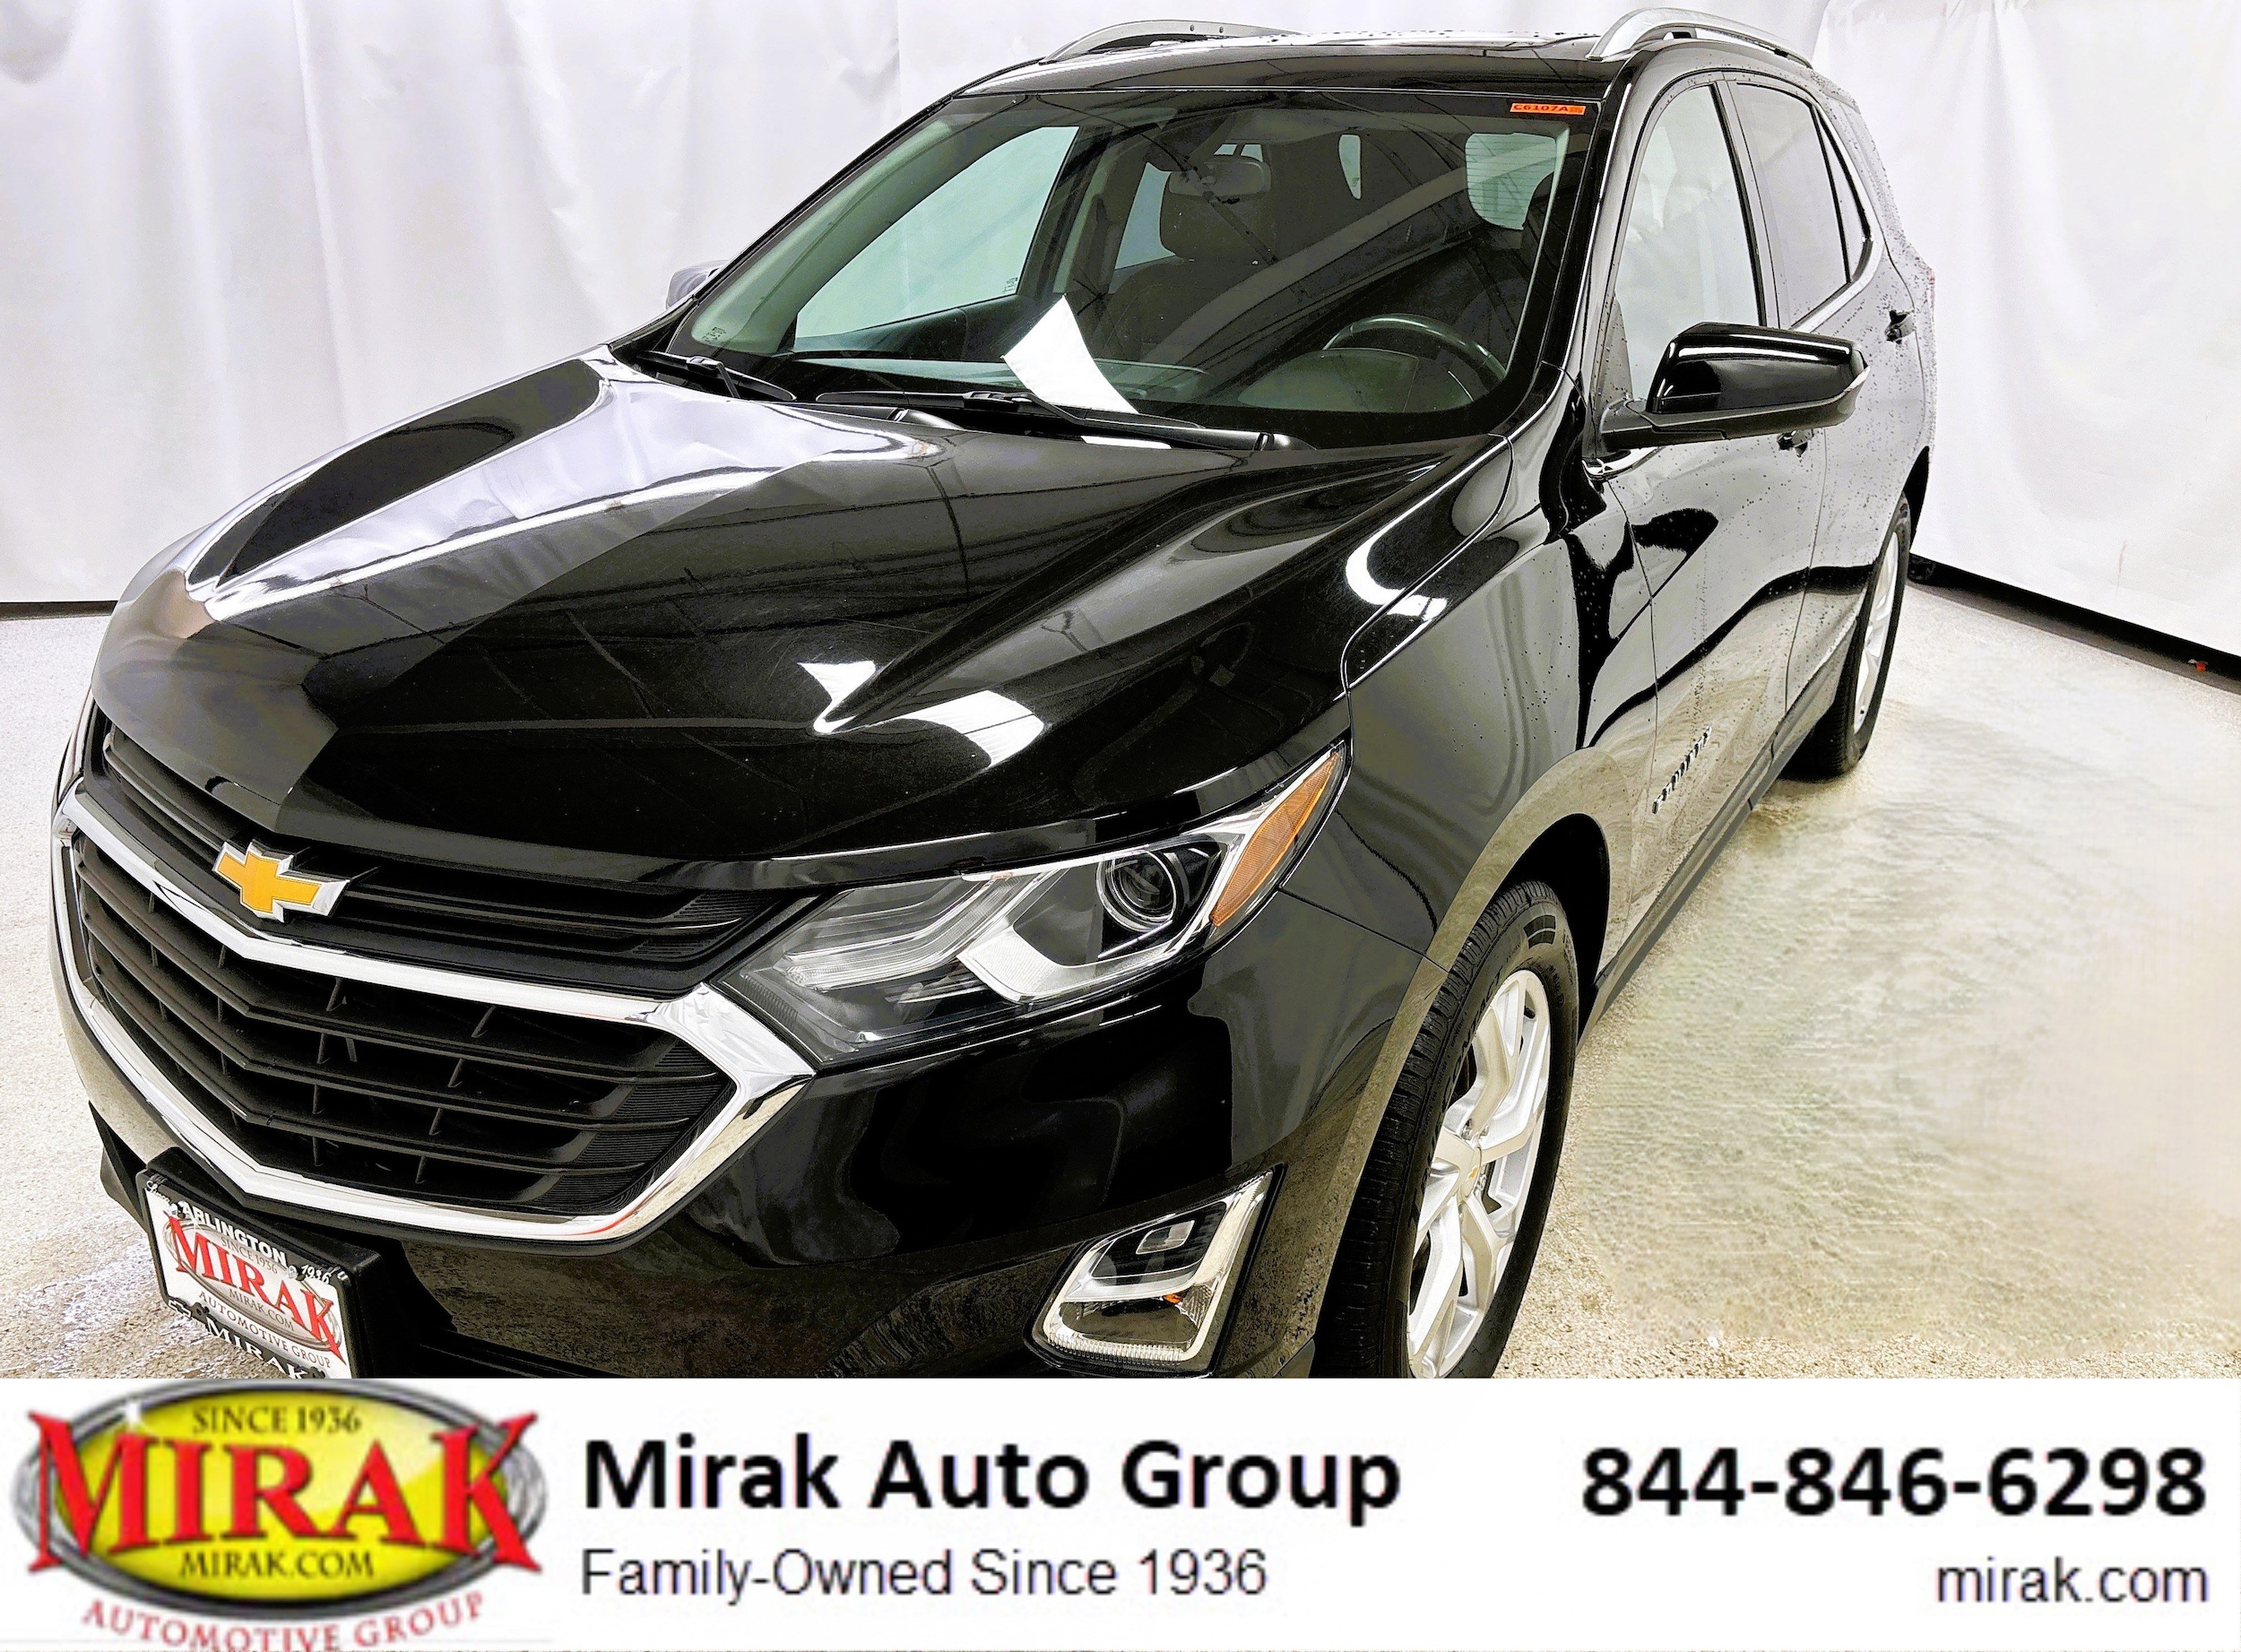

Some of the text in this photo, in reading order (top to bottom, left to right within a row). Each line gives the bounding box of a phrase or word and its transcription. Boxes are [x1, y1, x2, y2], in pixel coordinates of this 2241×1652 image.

[1513, 104, 1569, 112] C6107A
[181, 1201, 288, 1269] ARLINGTON
[300, 1264, 332, 1285] 1936
[221, 1236, 278, 1276] SINCE 1936
[163, 1210, 347, 1365] MIRAK
[229, 1287, 295, 1332] MIRAK.COM
[198, 1291, 331, 1370] AUTOMOTIVE GROUP
[206, 1316, 309, 1379] MIRAK
